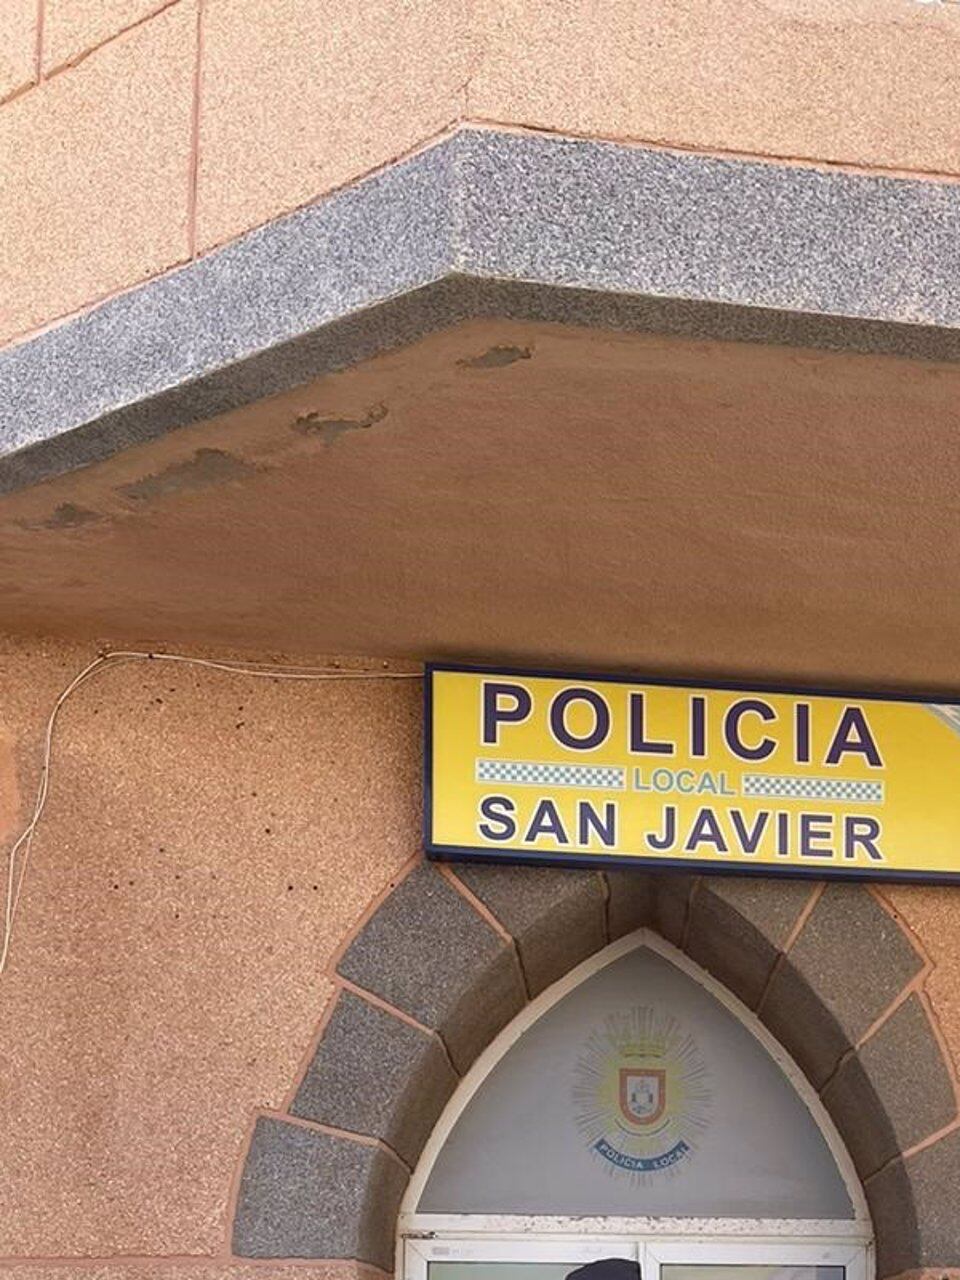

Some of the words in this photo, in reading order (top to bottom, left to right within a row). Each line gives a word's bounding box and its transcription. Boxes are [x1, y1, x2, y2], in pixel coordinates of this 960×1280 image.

[480, 681, 885, 769] POLICIA
[634, 768, 736, 796] LOCAL
[478, 796, 617, 847] SAN
[646, 805, 884, 861] JAVIER
